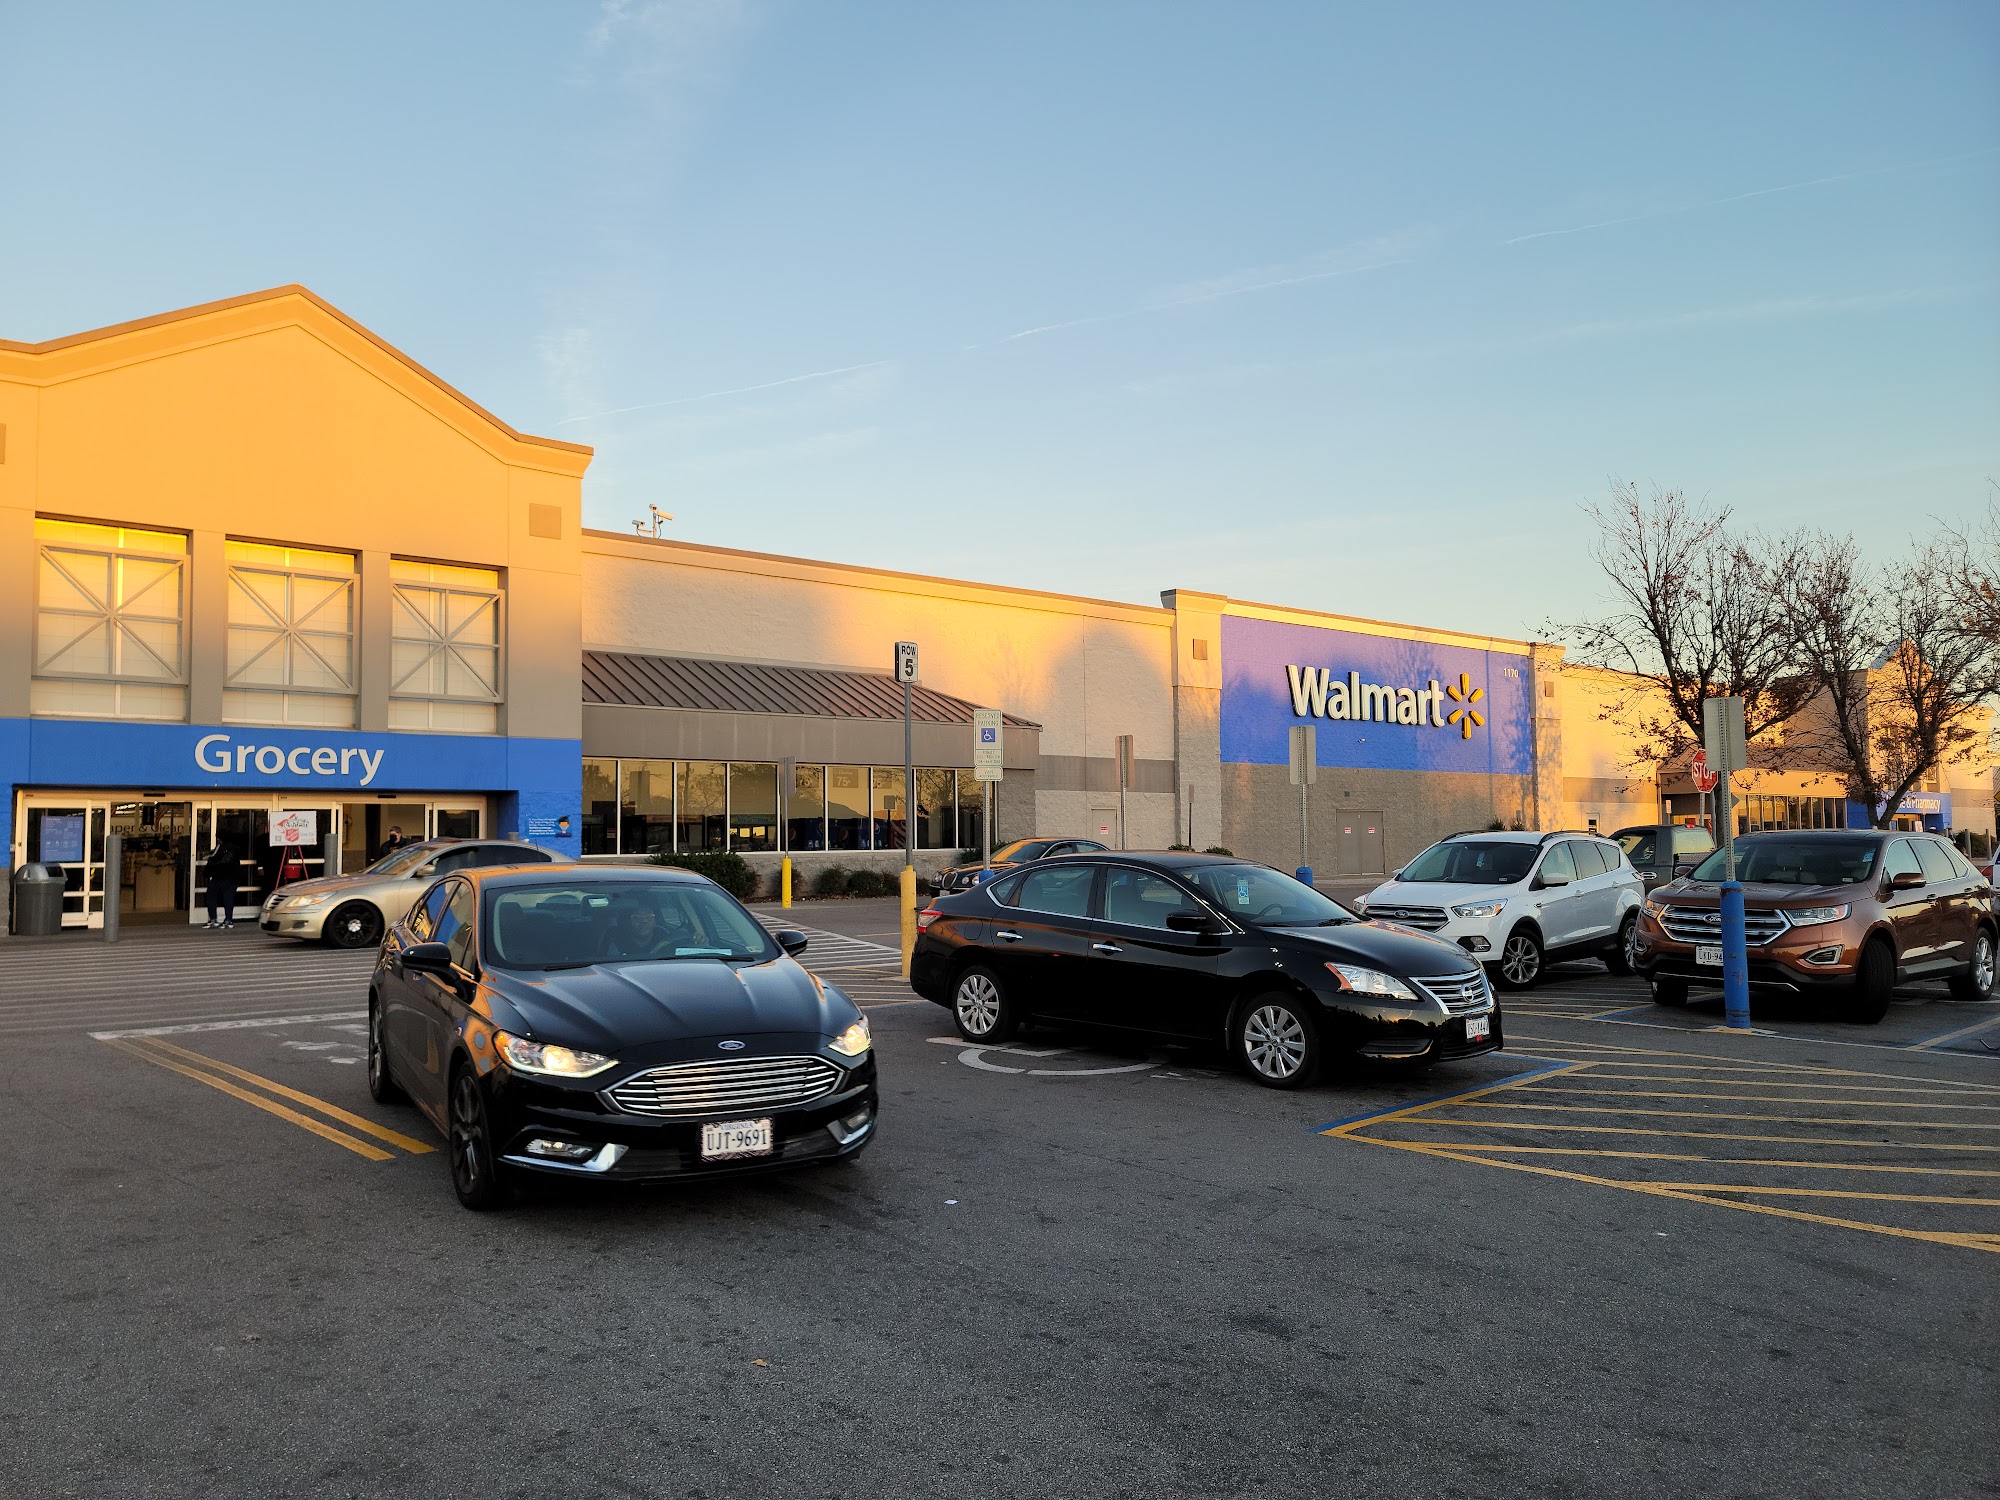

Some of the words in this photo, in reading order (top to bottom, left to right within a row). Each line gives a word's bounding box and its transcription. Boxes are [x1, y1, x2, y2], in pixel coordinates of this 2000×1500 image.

[901, 645, 916, 655] ROW
[904, 659, 914, 677] 5
[1503, 667, 1519, 678] 1170
[1286, 664, 1445, 728] Walmart
[194, 734, 385, 787] Grocery
[138, 823, 148, 832] &
[706, 1129, 767, 1151] UJT-9691
